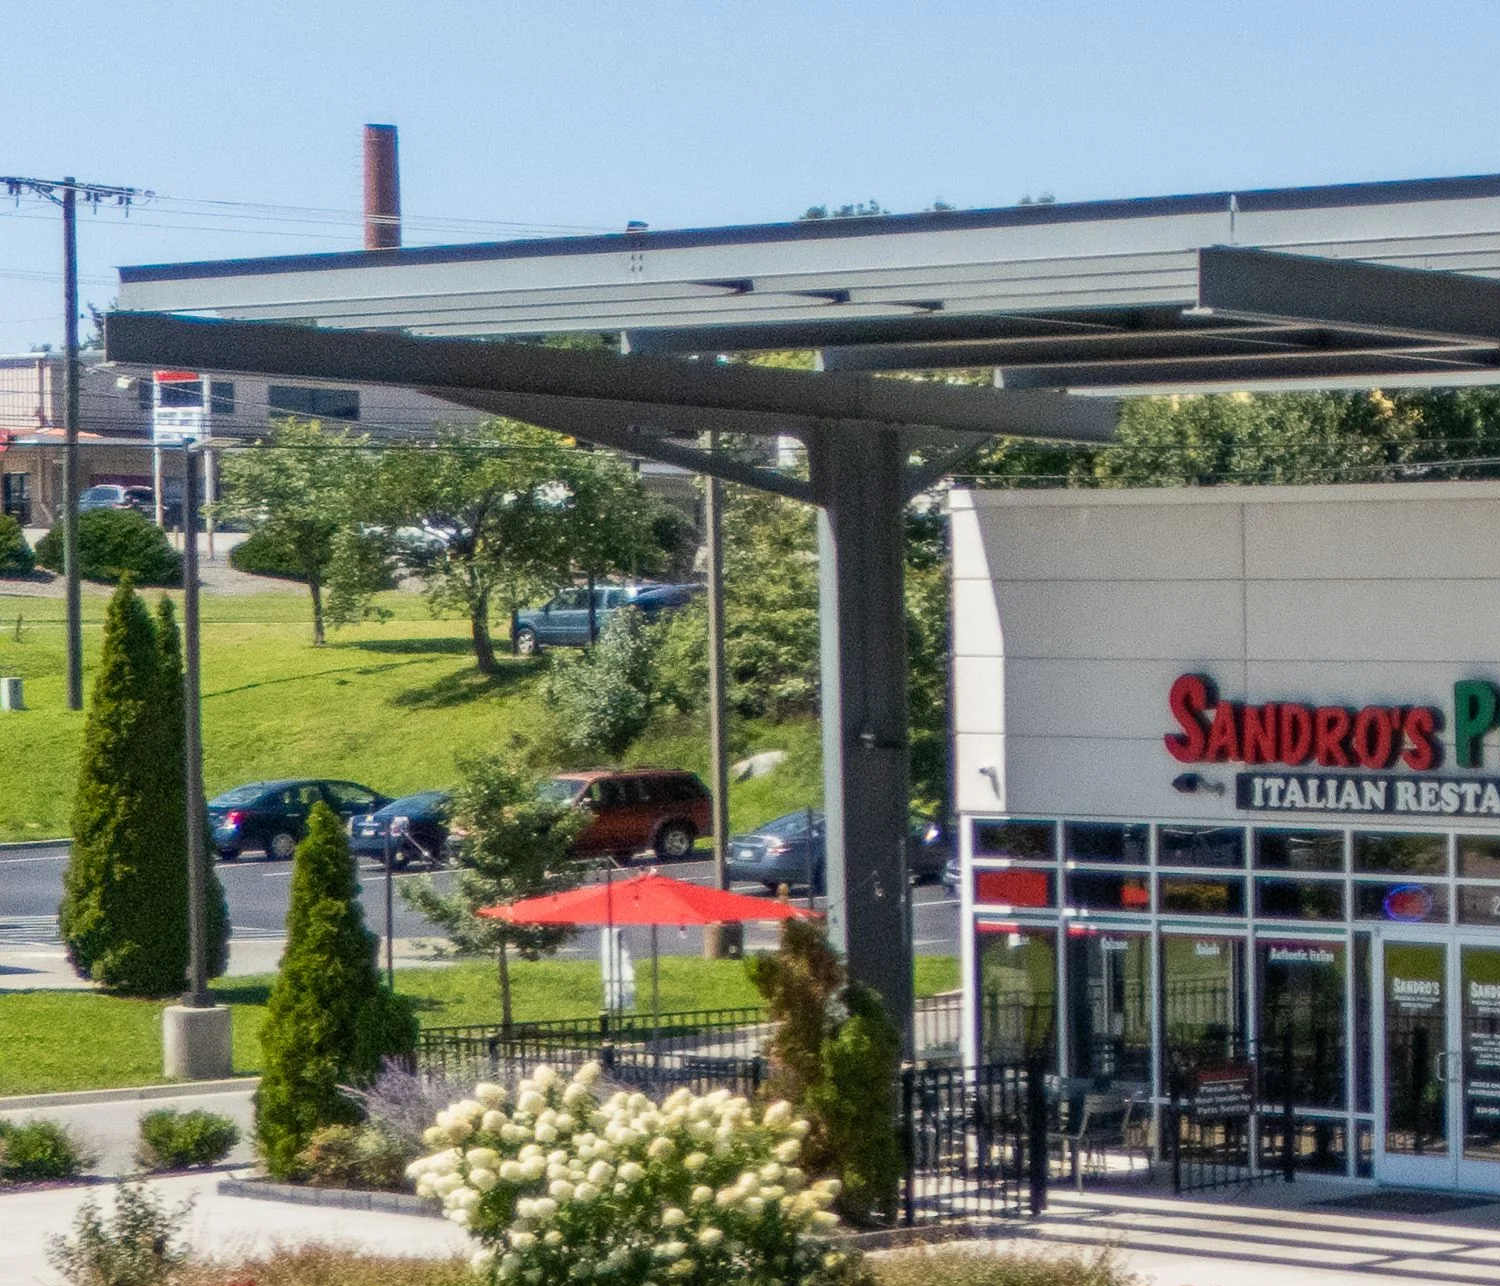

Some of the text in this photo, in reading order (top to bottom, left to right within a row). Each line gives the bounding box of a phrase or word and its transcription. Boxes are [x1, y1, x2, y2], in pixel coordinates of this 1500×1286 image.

[1164, 673, 1440, 772] SANDRO'S
[1252, 777, 1387, 811] ITALIAN
[1270, 947, 1306, 963] Authentic
[1393, 977, 1440, 996] SANDRO'S
